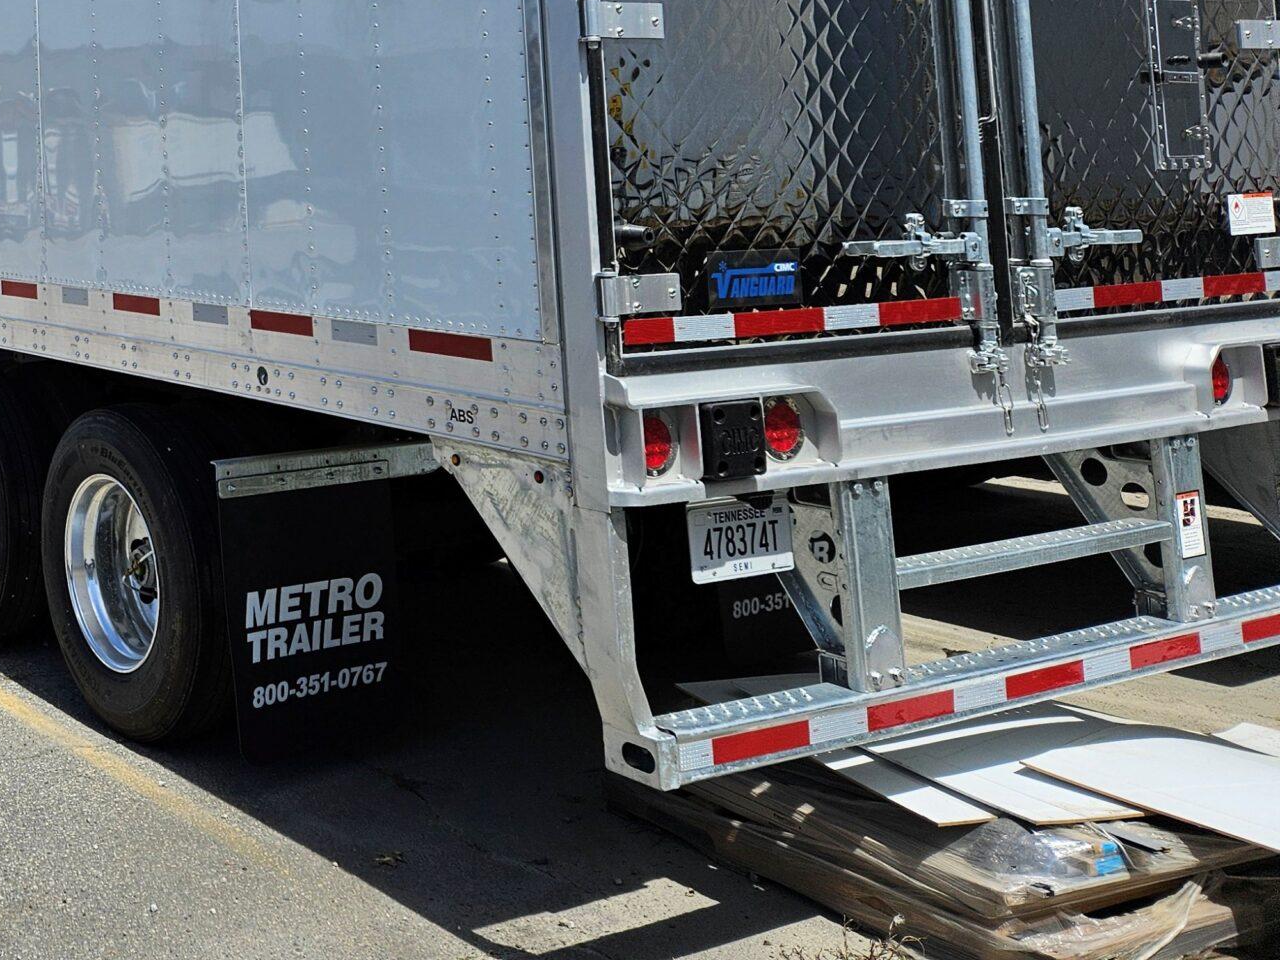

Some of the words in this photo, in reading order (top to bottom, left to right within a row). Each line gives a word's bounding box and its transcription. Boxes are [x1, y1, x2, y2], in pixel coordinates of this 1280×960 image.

[773, 262, 796, 272] CIMC
[711, 269, 795, 299] VANGUARD
[450, 407, 474, 424] ABS
[713, 507, 766, 524] TENNESSEE
[703, 519, 779, 560] 478374T
[733, 561, 753, 572] SEMI
[245, 572, 384, 629] METRO
[246, 610, 385, 664] TRAILER
[252, 661, 388, 709] 800-351-0767
